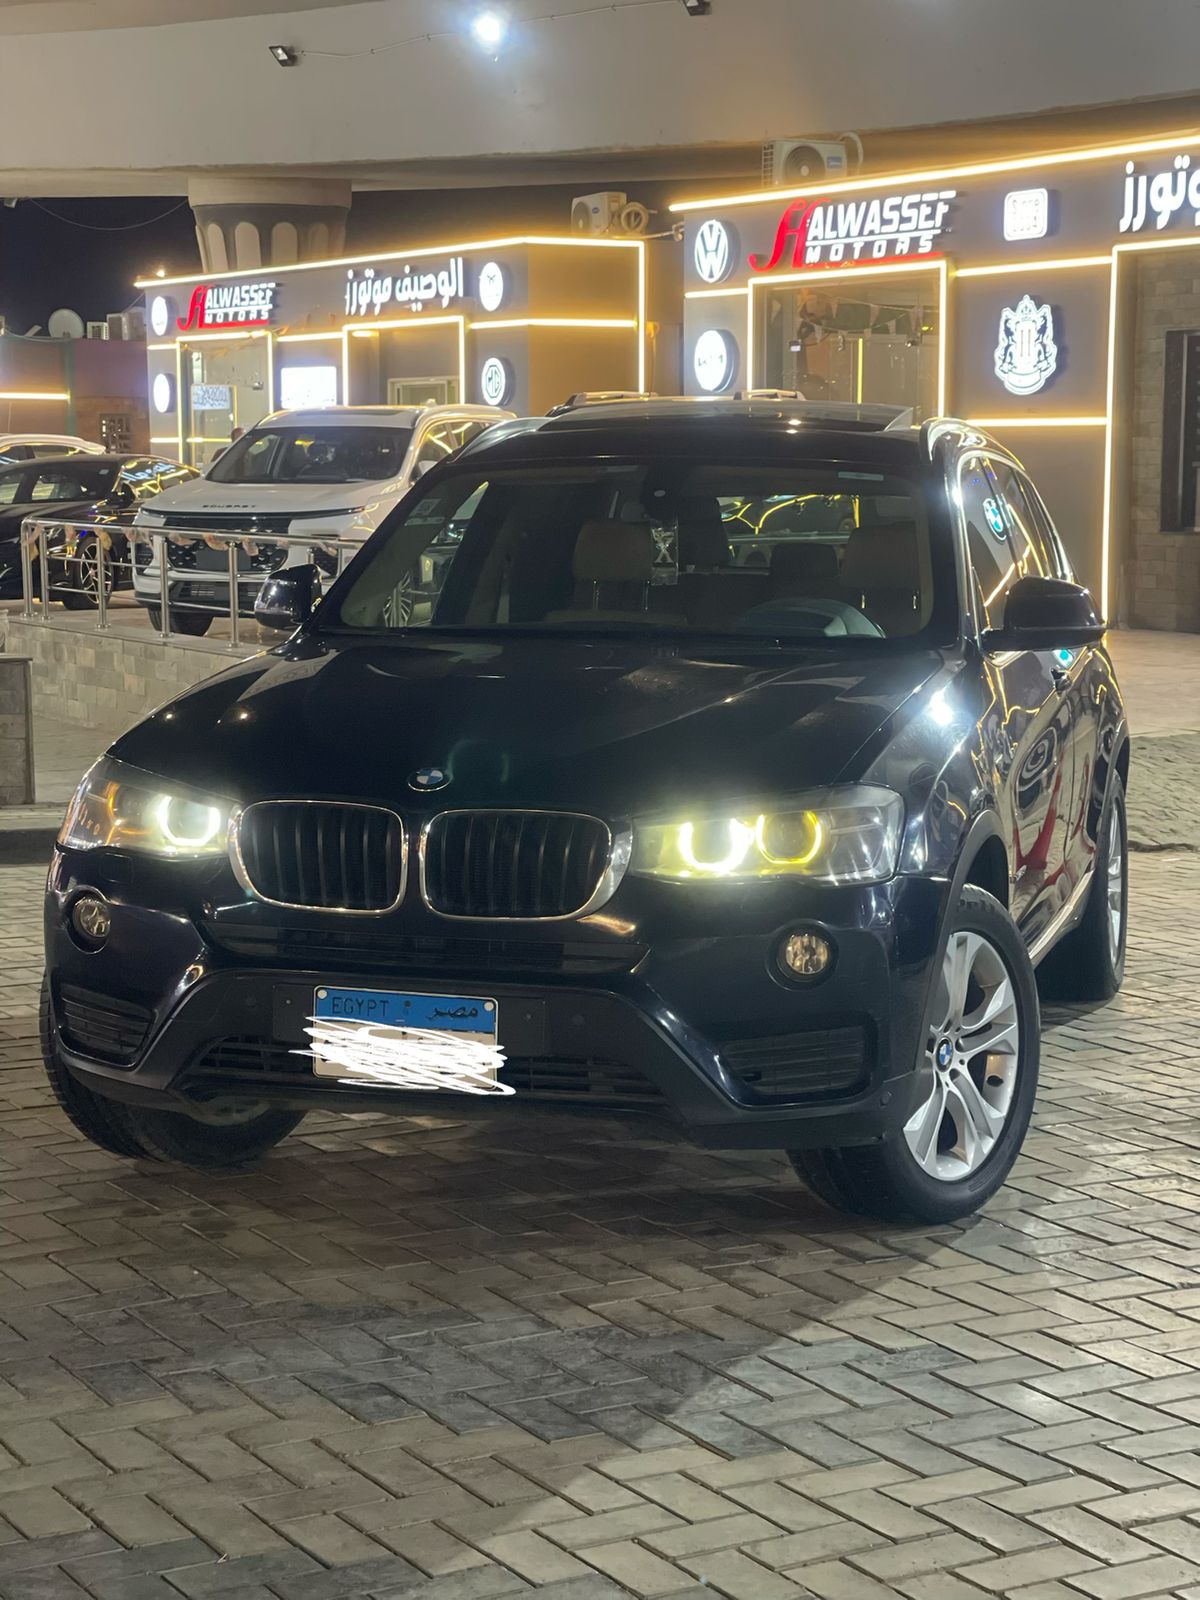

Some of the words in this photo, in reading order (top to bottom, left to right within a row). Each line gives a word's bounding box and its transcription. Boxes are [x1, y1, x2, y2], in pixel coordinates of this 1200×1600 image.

[806, 190, 957, 242] ALWASSEF
[1119, 154, 1200, 233] وتورز
[805, 234, 934, 265] MOTORS
[344, 268, 392, 316] موتورز
[395, 257, 464, 313] الوصيف
[204, 309, 269, 324] MOTORS
[331, 996, 390, 1018] EGYPT
[426, 1004, 480, 1021] مصر
